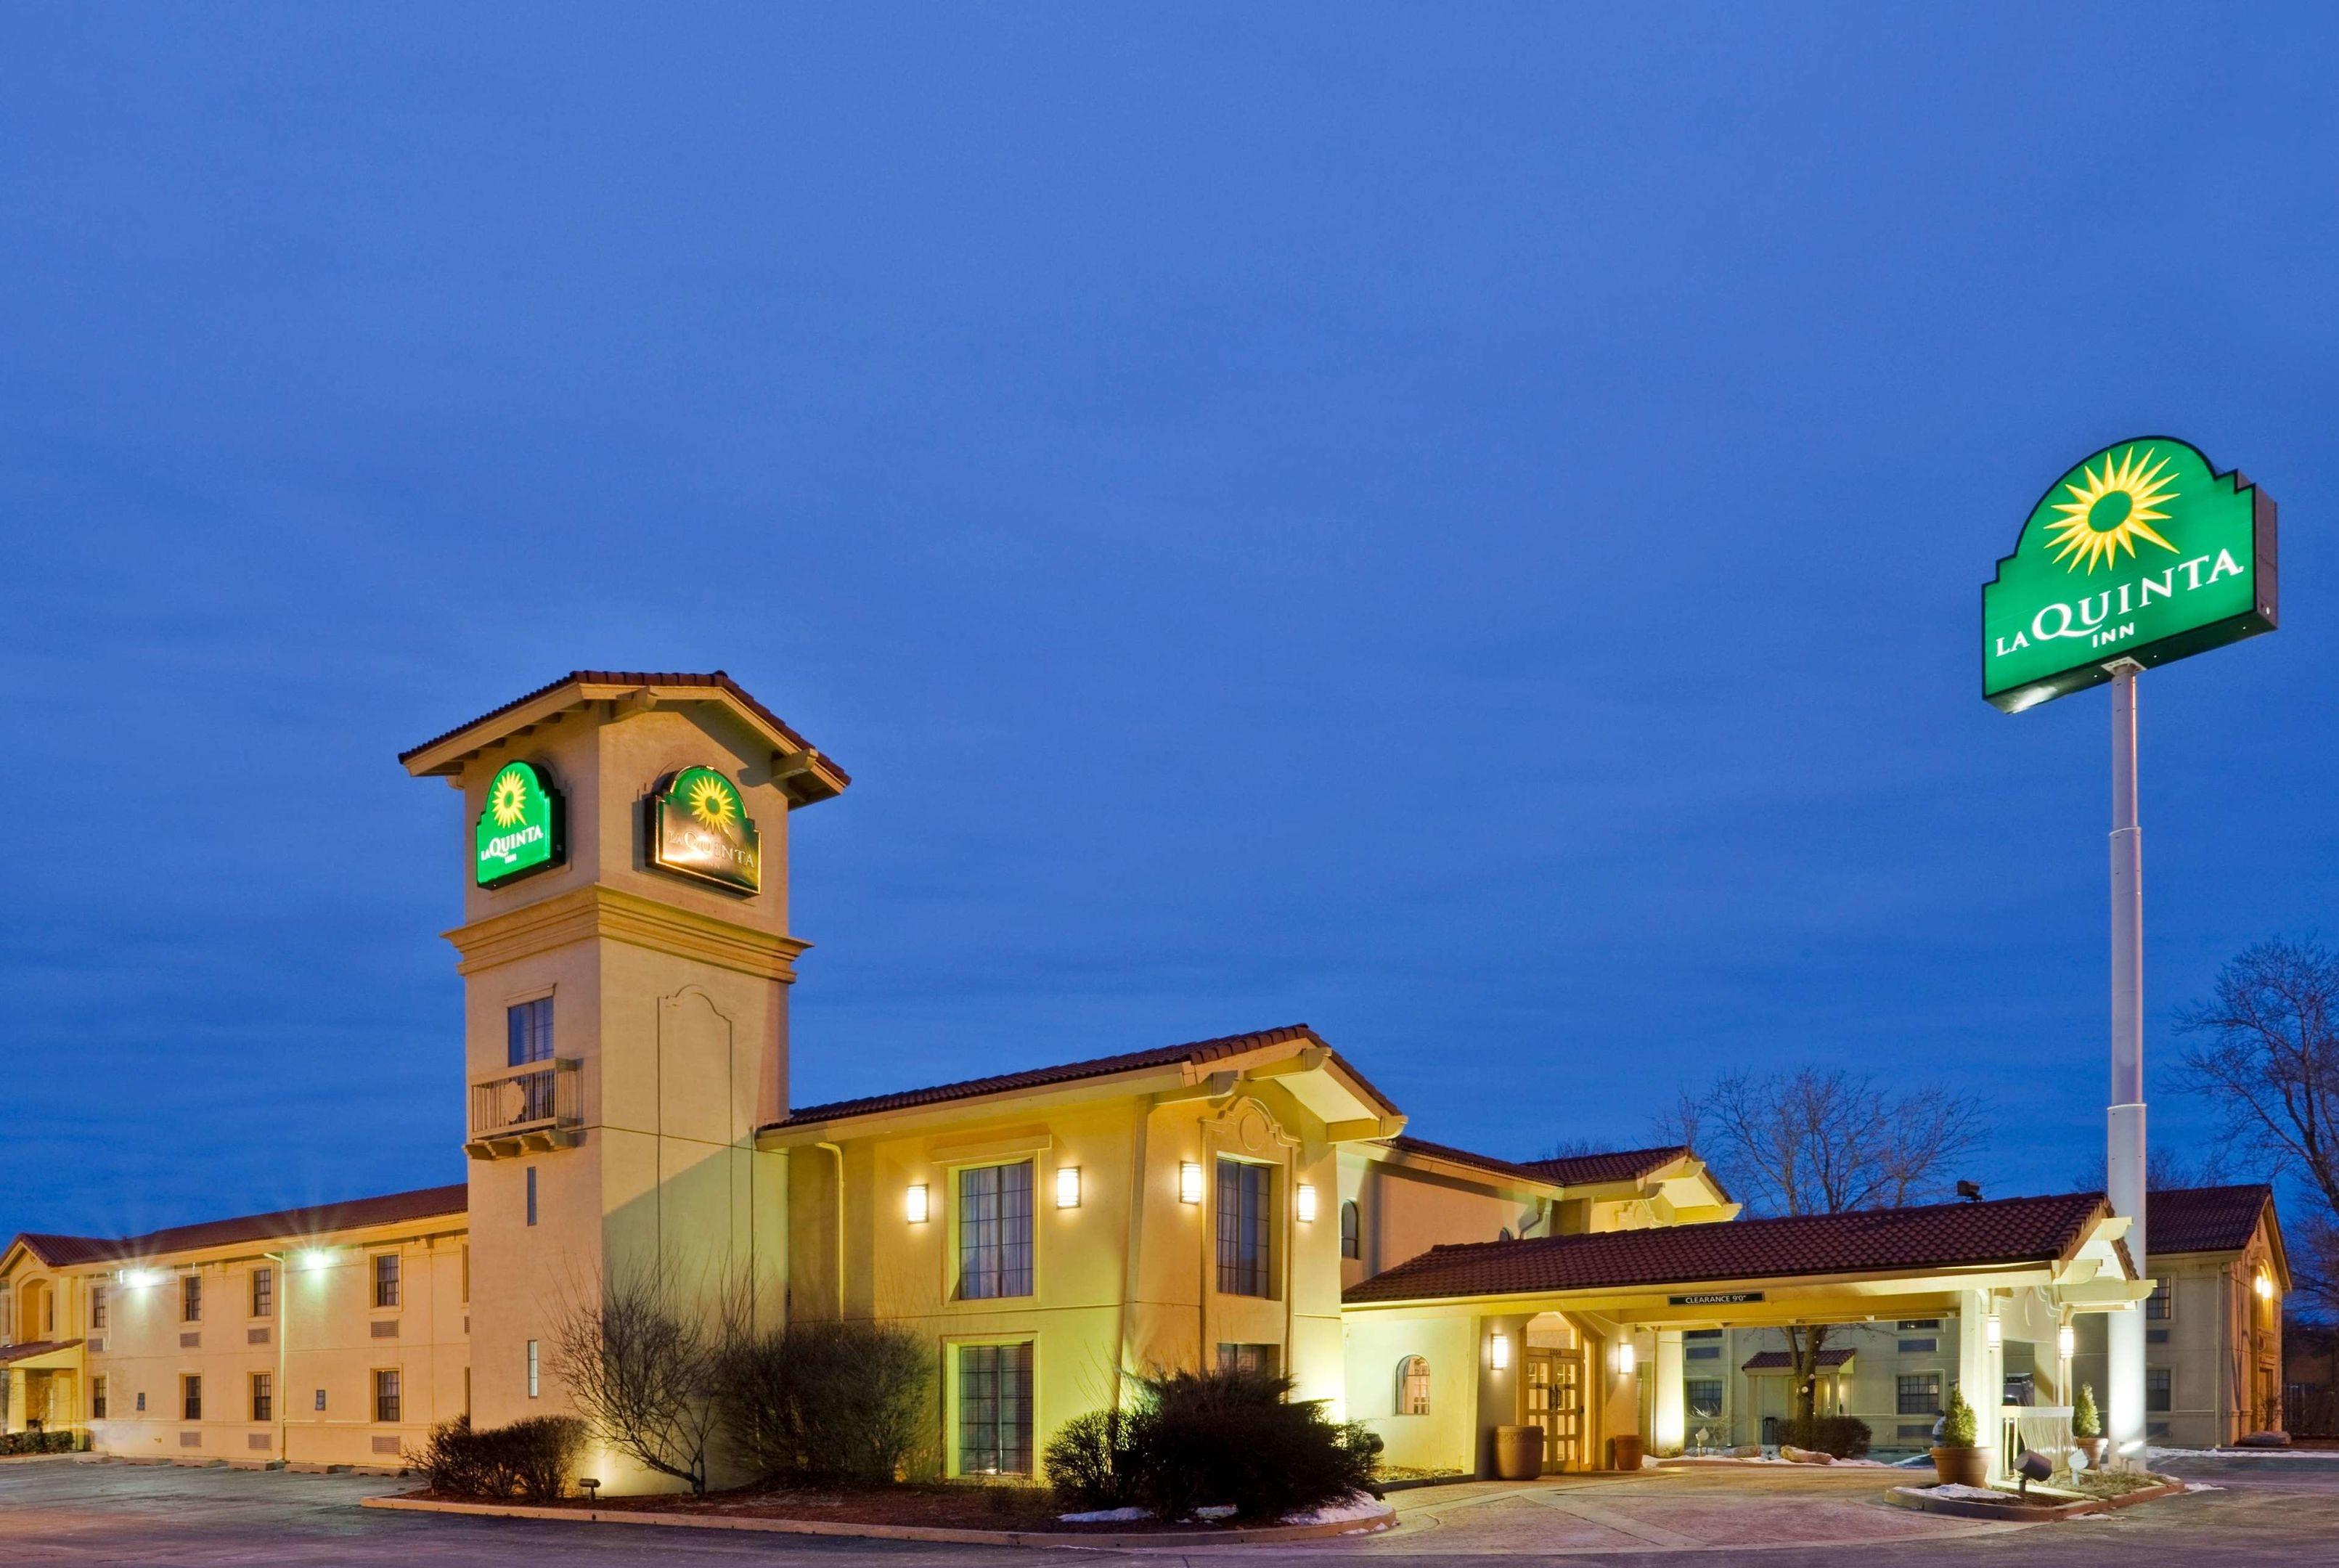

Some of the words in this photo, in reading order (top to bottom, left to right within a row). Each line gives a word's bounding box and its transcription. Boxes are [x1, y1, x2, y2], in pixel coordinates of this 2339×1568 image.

[1995, 630, 2030, 657] LA
[2032, 548, 2245, 640] QUINTA
[2092, 622, 2135, 648] INN
[481, 849, 491, 862] LA
[489, 825, 544, 858] QUINTA
[683, 830, 755, 869] QUINTA
[1685, 1295, 1731, 1304] CLEARANCE
